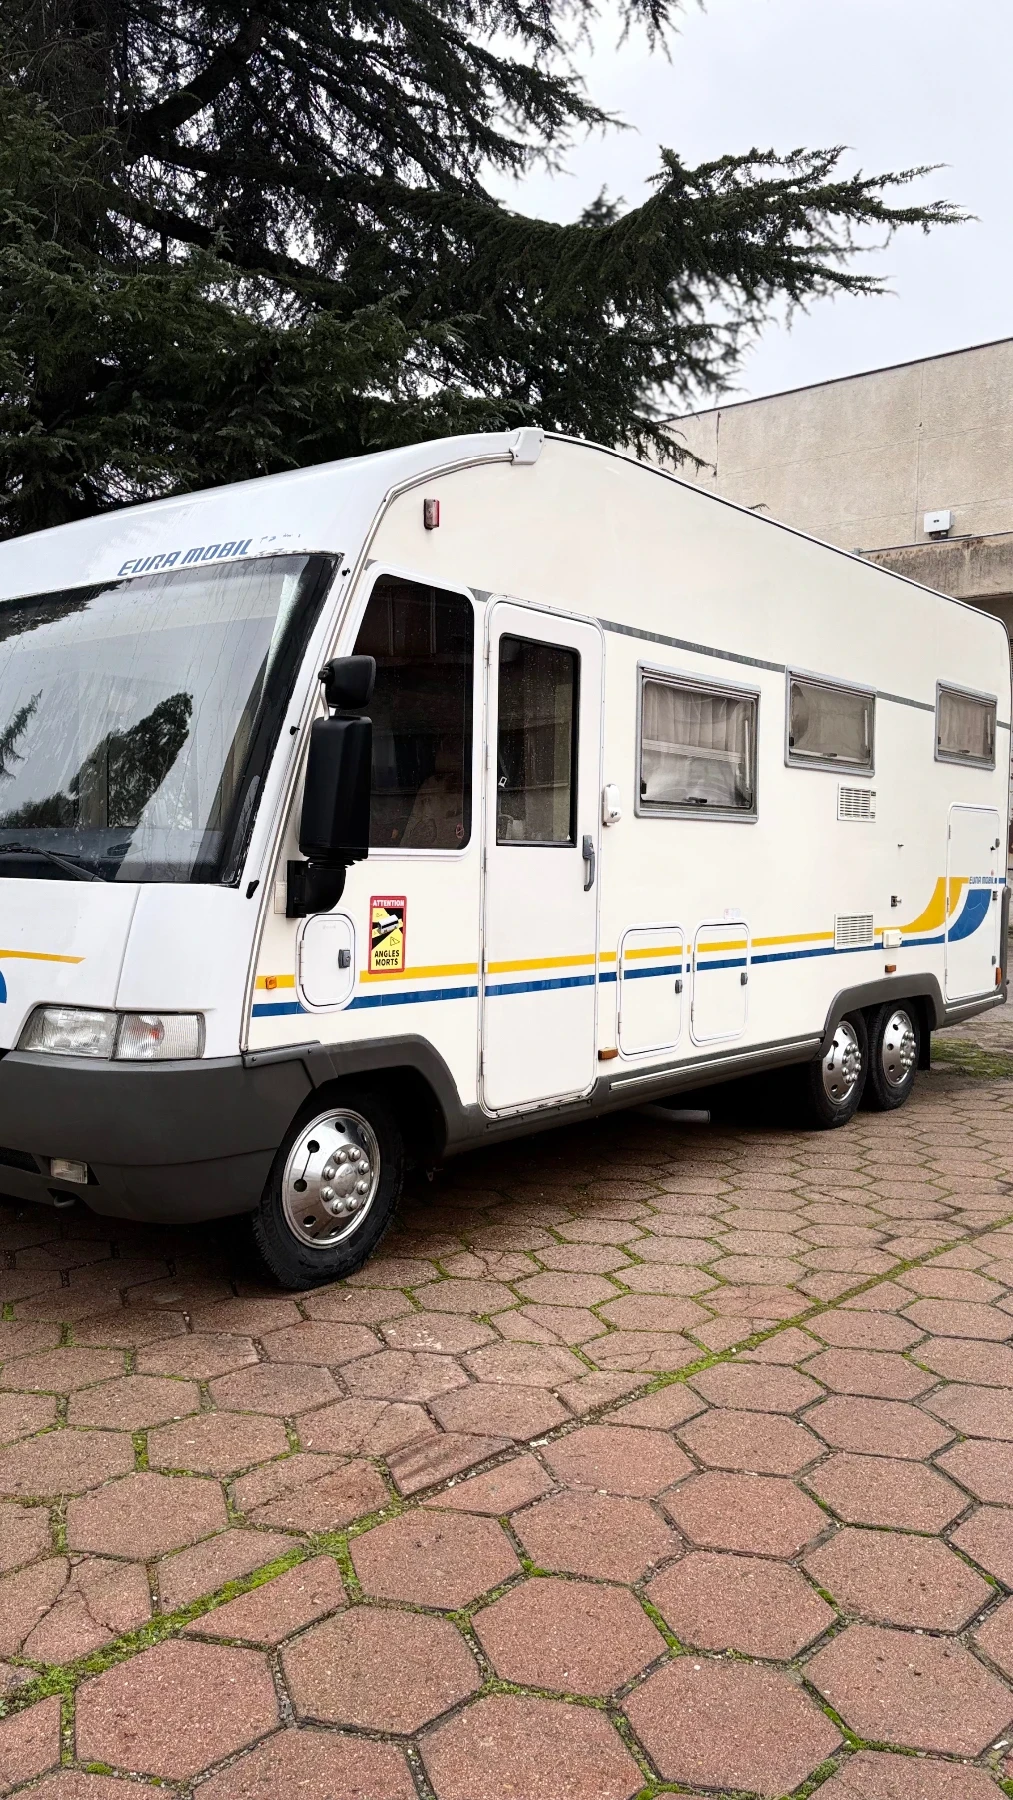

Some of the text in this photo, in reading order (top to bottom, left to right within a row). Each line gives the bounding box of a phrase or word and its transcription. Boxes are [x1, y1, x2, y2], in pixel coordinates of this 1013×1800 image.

[117, 551, 182, 577] EURA
[180, 538, 253, 565] MOBIL
[373, 899, 405, 907] ATTENTION
[374, 950, 400, 958] ANGLES
[375, 958, 399, 967] MORTS
